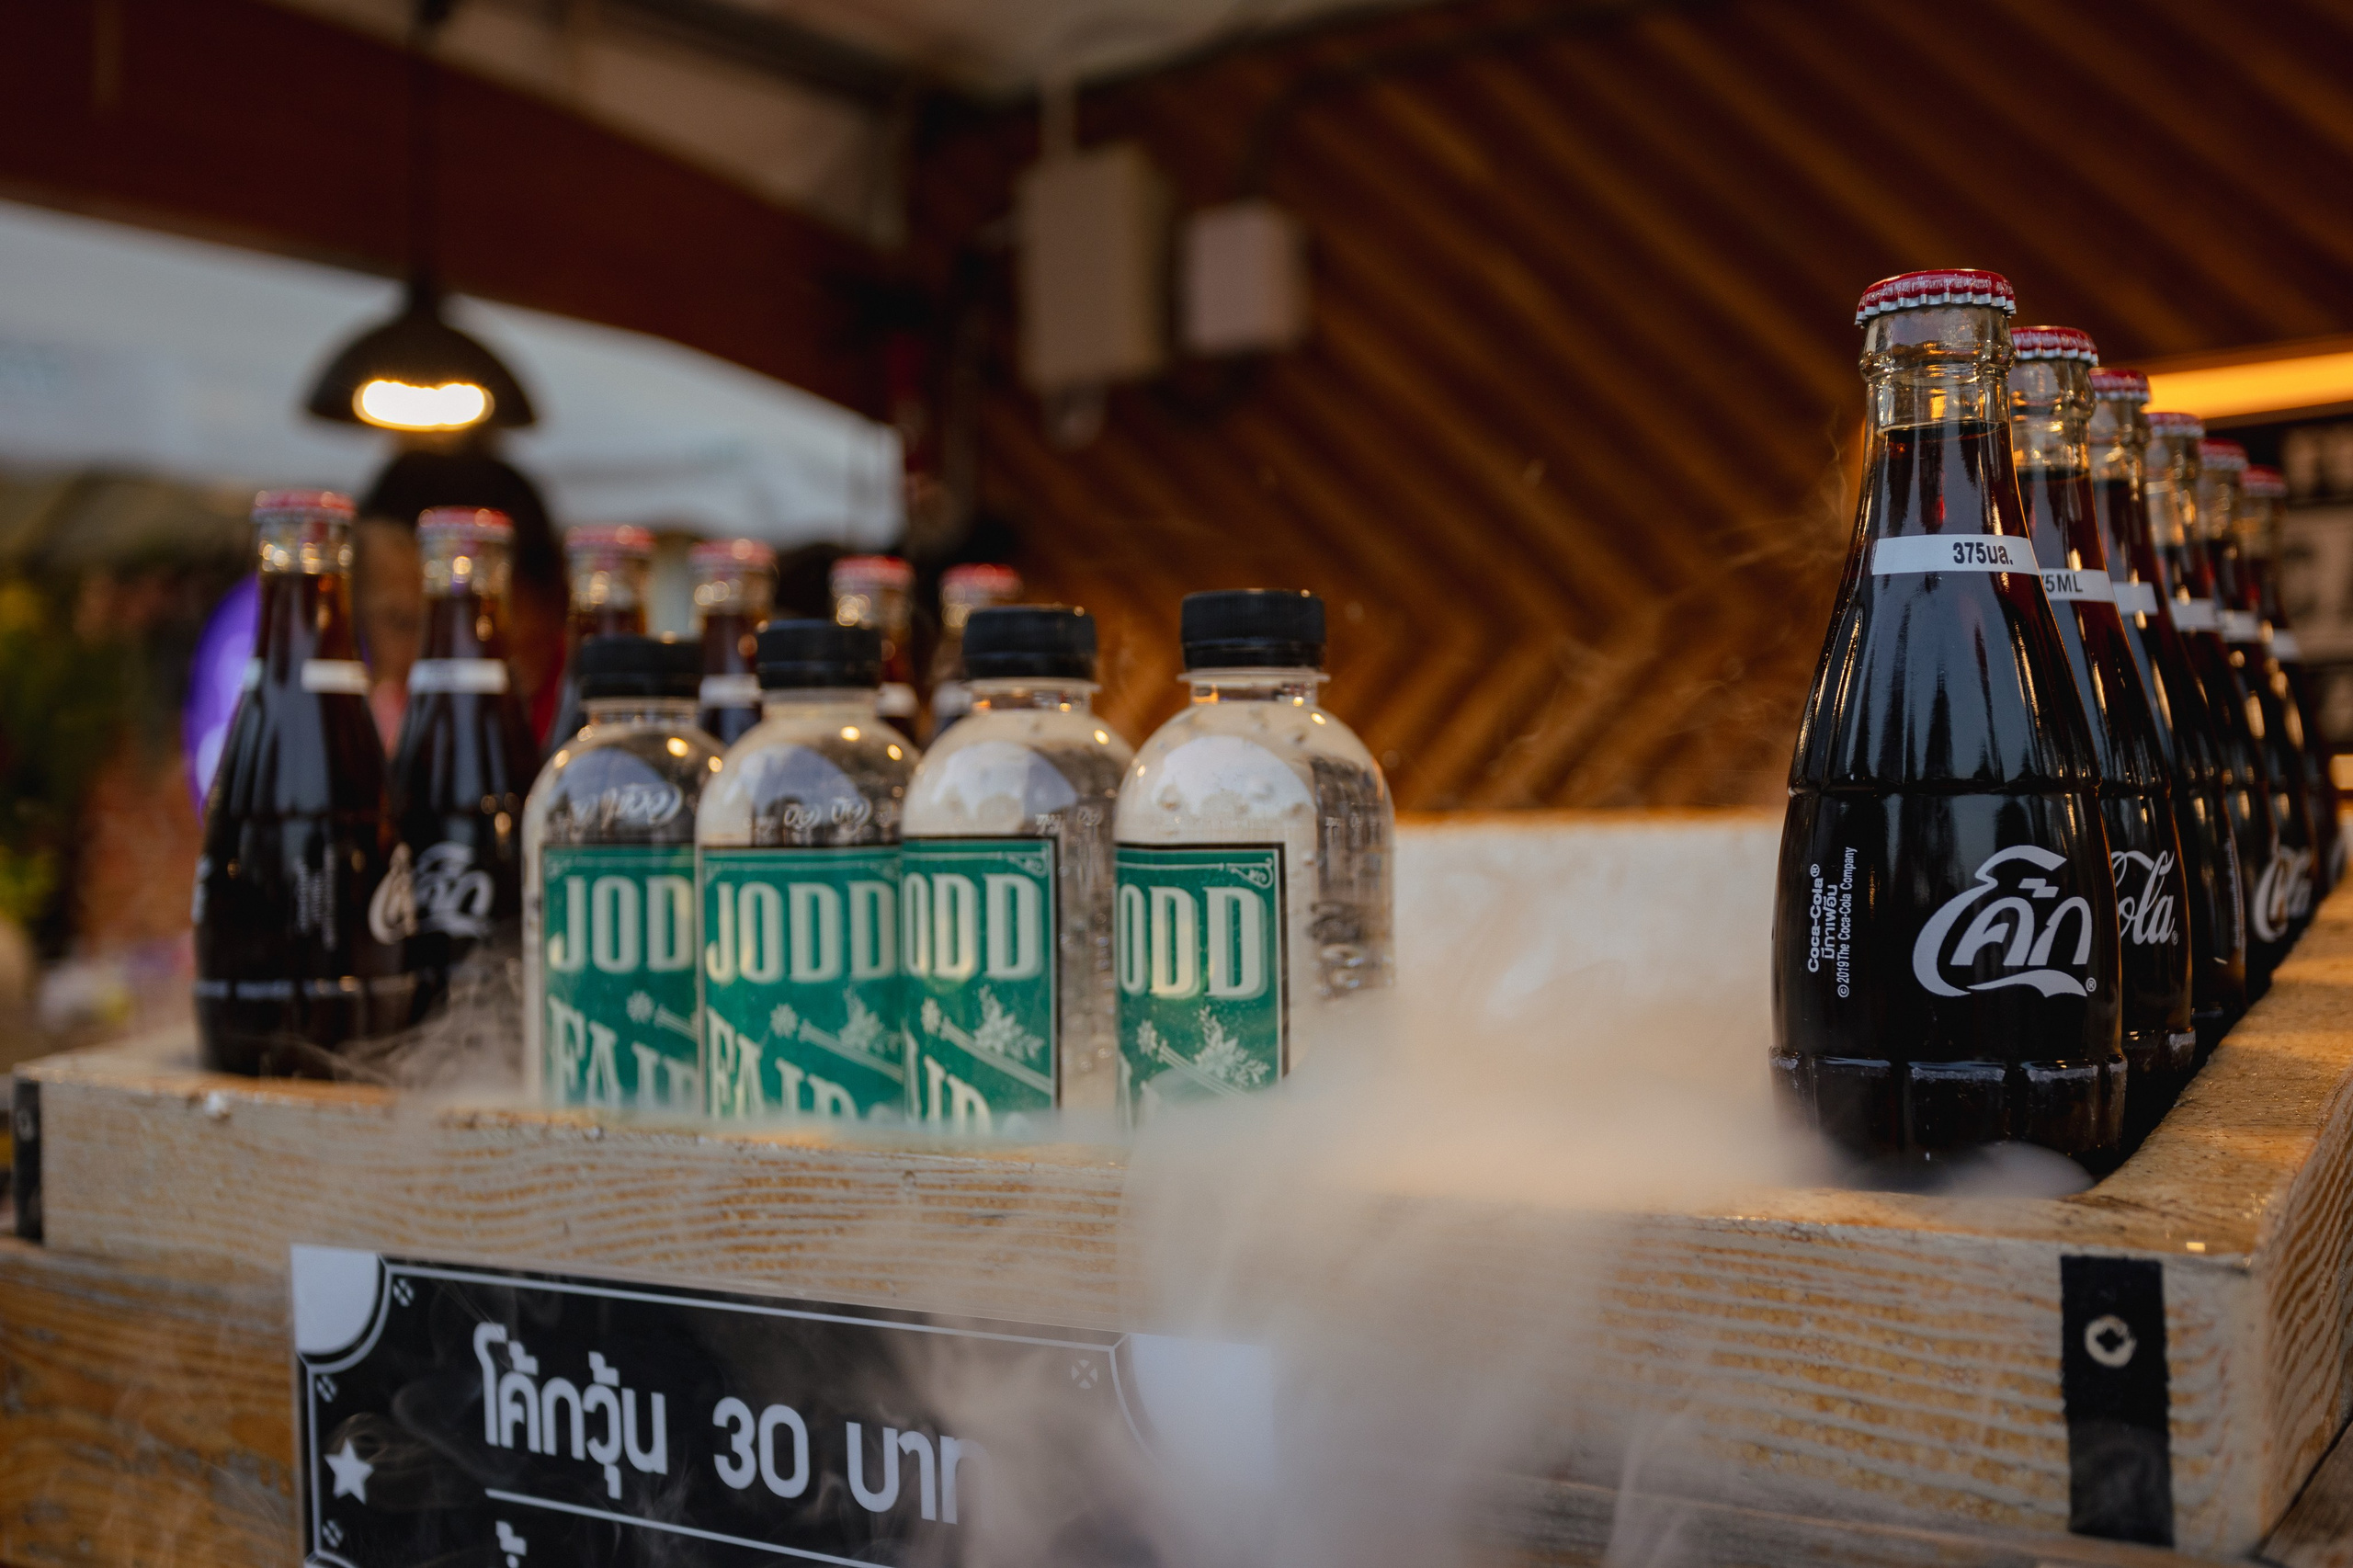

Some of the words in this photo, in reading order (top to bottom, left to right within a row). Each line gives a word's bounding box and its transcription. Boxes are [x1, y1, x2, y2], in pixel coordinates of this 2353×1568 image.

[2040, 572, 2084, 593] 5ML
[1840, 846, 1859, 890] Company
[548, 875, 695, 972] JOD
[705, 881, 898, 984] JODD
[904, 871, 1043, 981] ODD
[1119, 883, 1267, 999] ODD
[472, 1321, 668, 1501] โค้กวุ้น
[712, 1396, 810, 1498] 30
